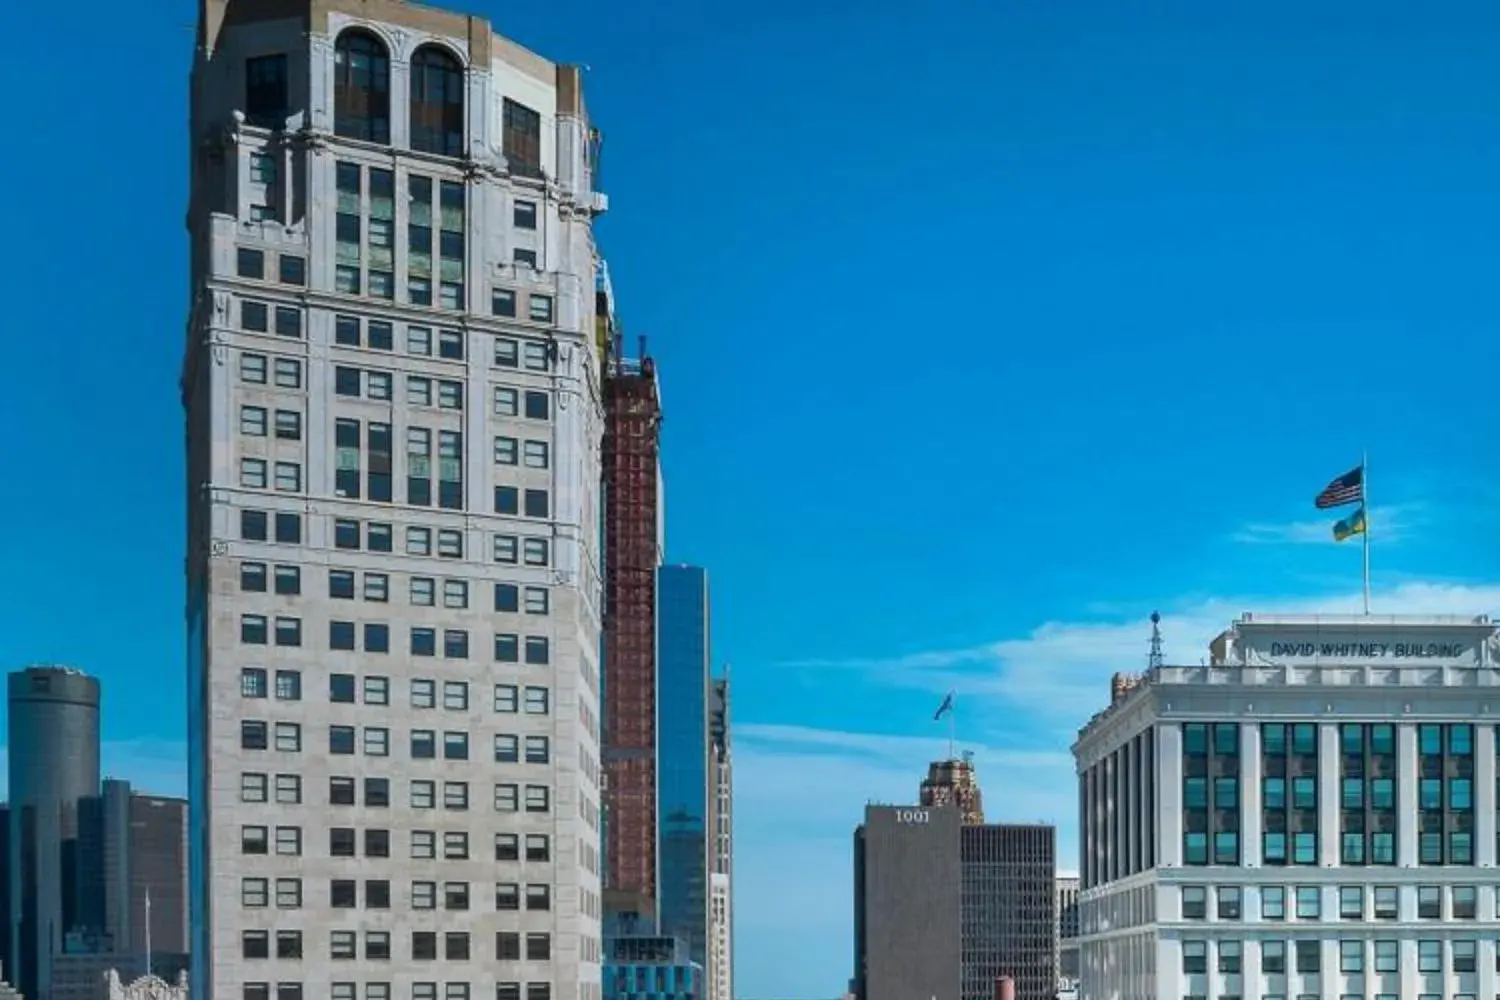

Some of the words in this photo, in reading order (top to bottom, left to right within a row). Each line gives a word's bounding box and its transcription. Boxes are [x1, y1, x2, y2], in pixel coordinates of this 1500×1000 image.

[1271, 641, 1315, 657] DAVID
[1320, 642, 1388, 657] WHITNEY
[1395, 643, 1463, 657] BUILDING
[896, 809, 929, 822] 1001
